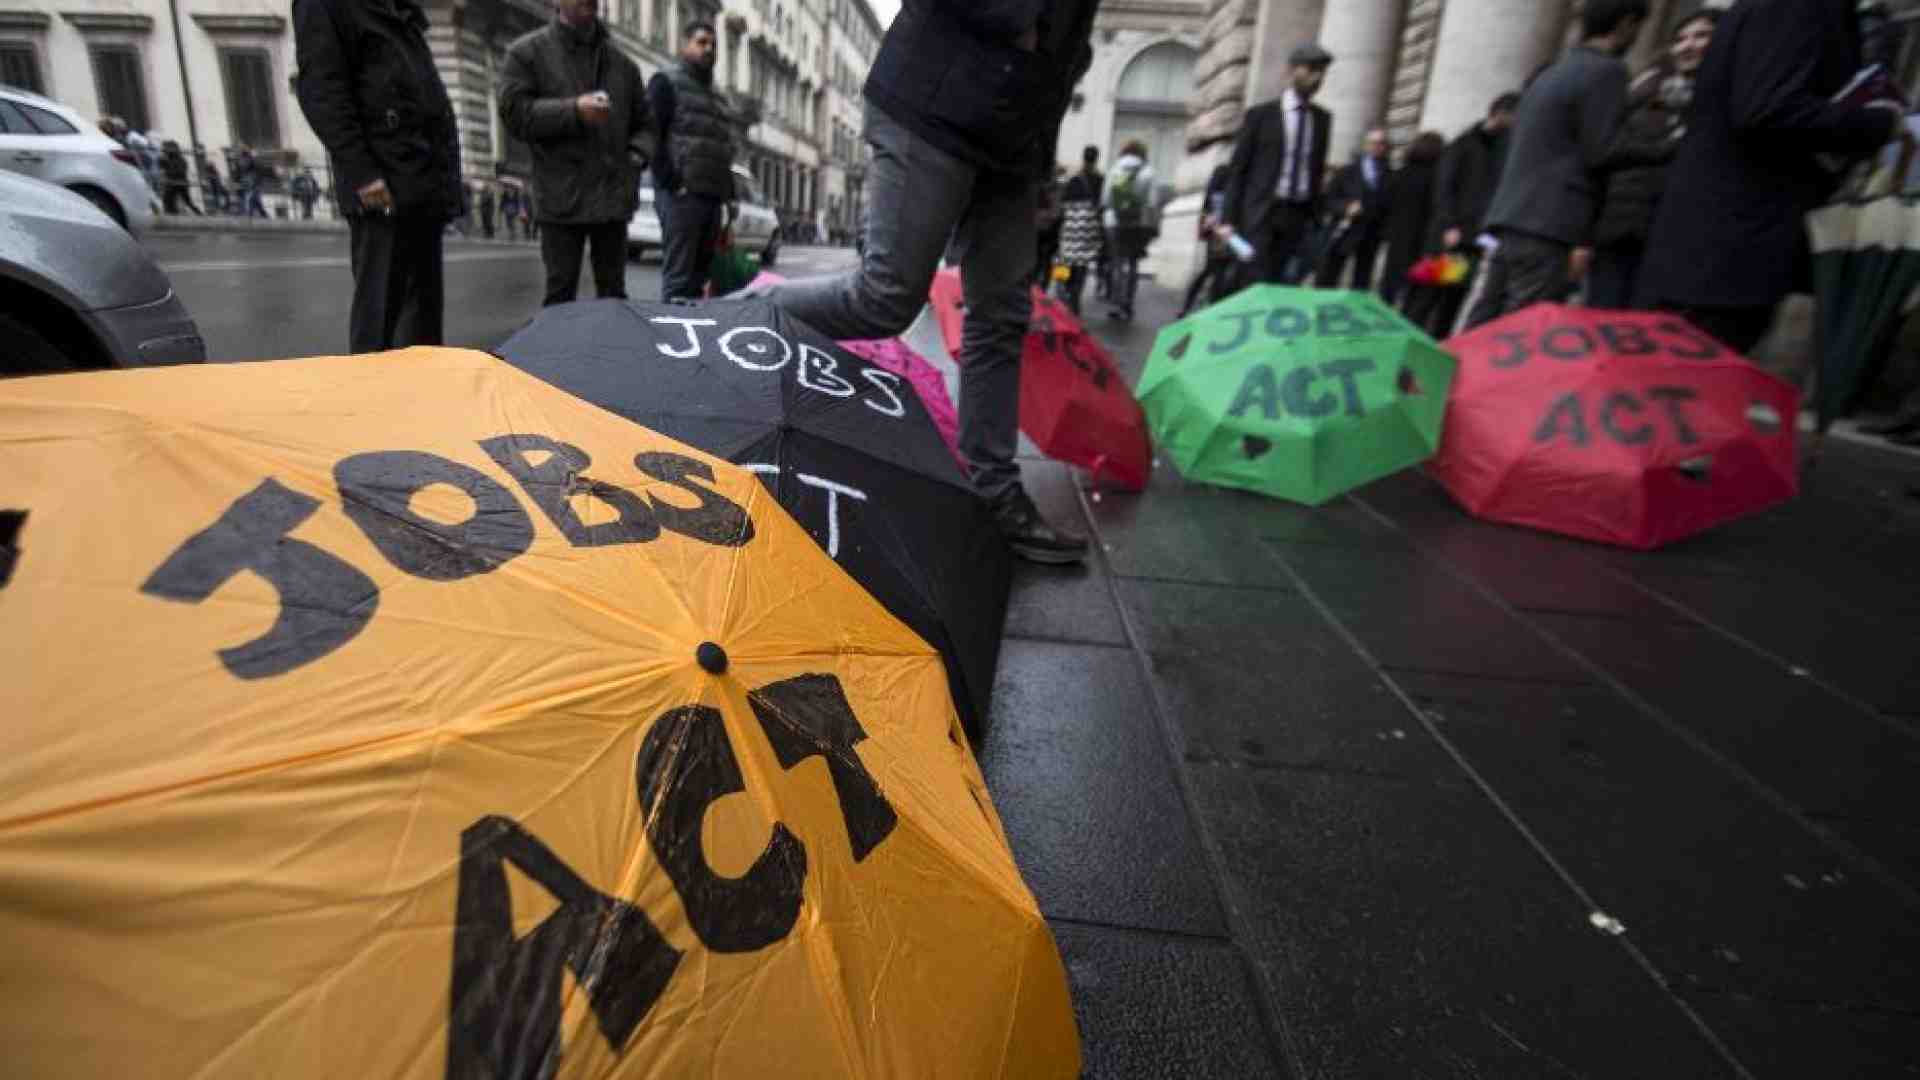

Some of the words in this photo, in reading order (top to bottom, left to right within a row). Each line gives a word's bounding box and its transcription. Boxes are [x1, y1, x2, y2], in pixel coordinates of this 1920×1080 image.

[650, 317, 905, 417] JOBS
[1488, 321, 1722, 369] JOBS
[1228, 358, 1376, 420] ACT
[1532, 385, 1698, 447] ACT
[140, 434, 754, 680] JOBS
[444, 672, 897, 1080] ACT
